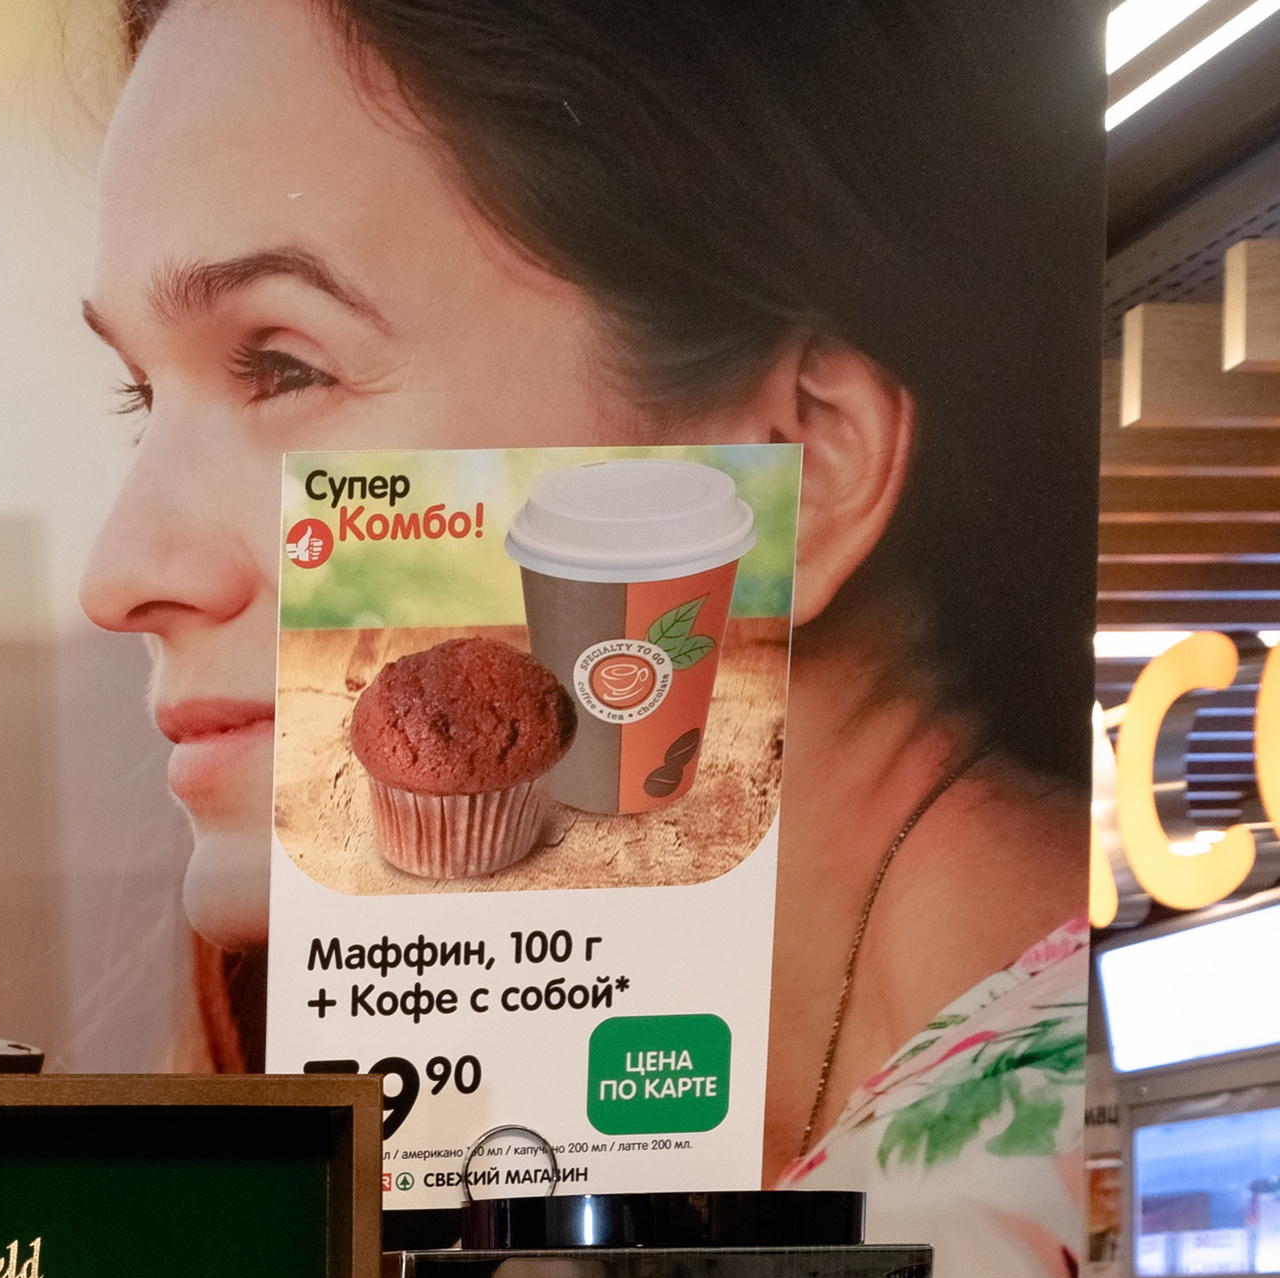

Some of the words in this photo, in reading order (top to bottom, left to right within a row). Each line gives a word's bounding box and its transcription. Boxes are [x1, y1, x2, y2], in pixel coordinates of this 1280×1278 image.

[305, 470, 410, 508] Супер
[339, 502, 484, 541] Комбо!
[580, 643, 633, 671] SPECIALTY
[637, 645, 652, 656] TO
[652, 653, 665, 665] GO
[578, 681, 597, 709] coffee
[607, 712, 624, 720] tea
[637, 673, 669, 716] chocolate
[307, 934, 495, 977] Маффин,
[510, 930, 573, 964] 100
[585, 934, 603, 961] г
[351, 982, 458, 1024] Кофе
[470, 986, 489, 1013] с
[625, 1050, 693, 1075] ЦЕНА
[600, 1079, 636, 1101] ПО
[645, 1076, 717, 1098] КАРТЕ
[401, 1148, 463, 1161] американо
[487, 1147, 503, 1156] мл
[514, 1144, 565, 1158] капучно
[568, 1143, 588, 1154] 200
[591, 1142, 607, 1152] мл
[618, 1142, 648, 1151] латте
[651, 1139, 671, 1150] 200
[674, 1141, 693, 1150] мл.
